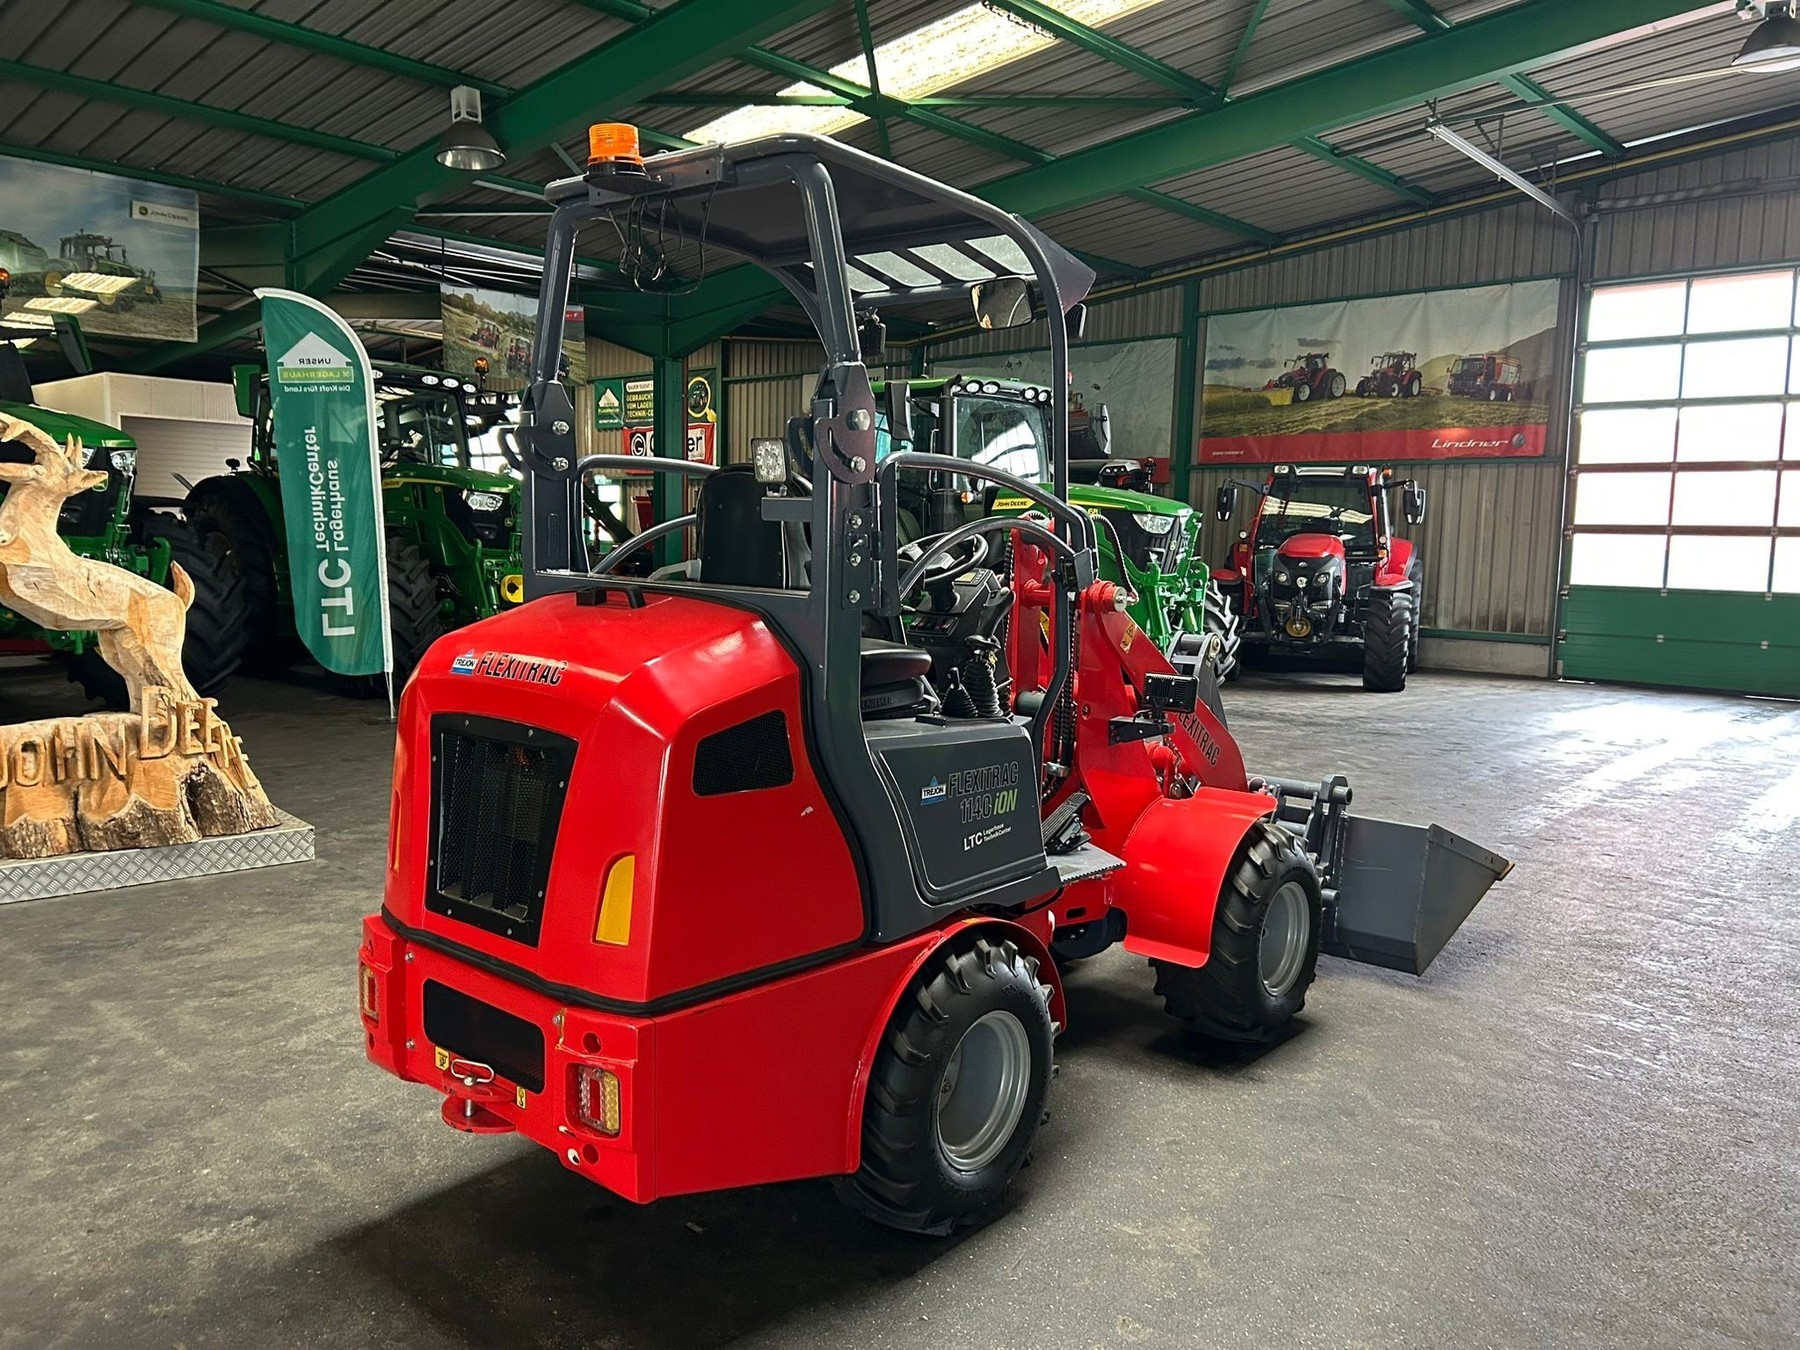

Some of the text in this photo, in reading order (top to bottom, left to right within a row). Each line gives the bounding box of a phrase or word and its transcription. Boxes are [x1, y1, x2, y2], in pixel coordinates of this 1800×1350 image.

[627, 410, 654, 418] TECHNIK-CE
[1431, 439, 1509, 448] Lindner
[455, 652, 568, 685] TREJON FLEXITRAC
[923, 761, 1019, 798] TREJON FLEXITRAC
[963, 832, 984, 851] LTC
